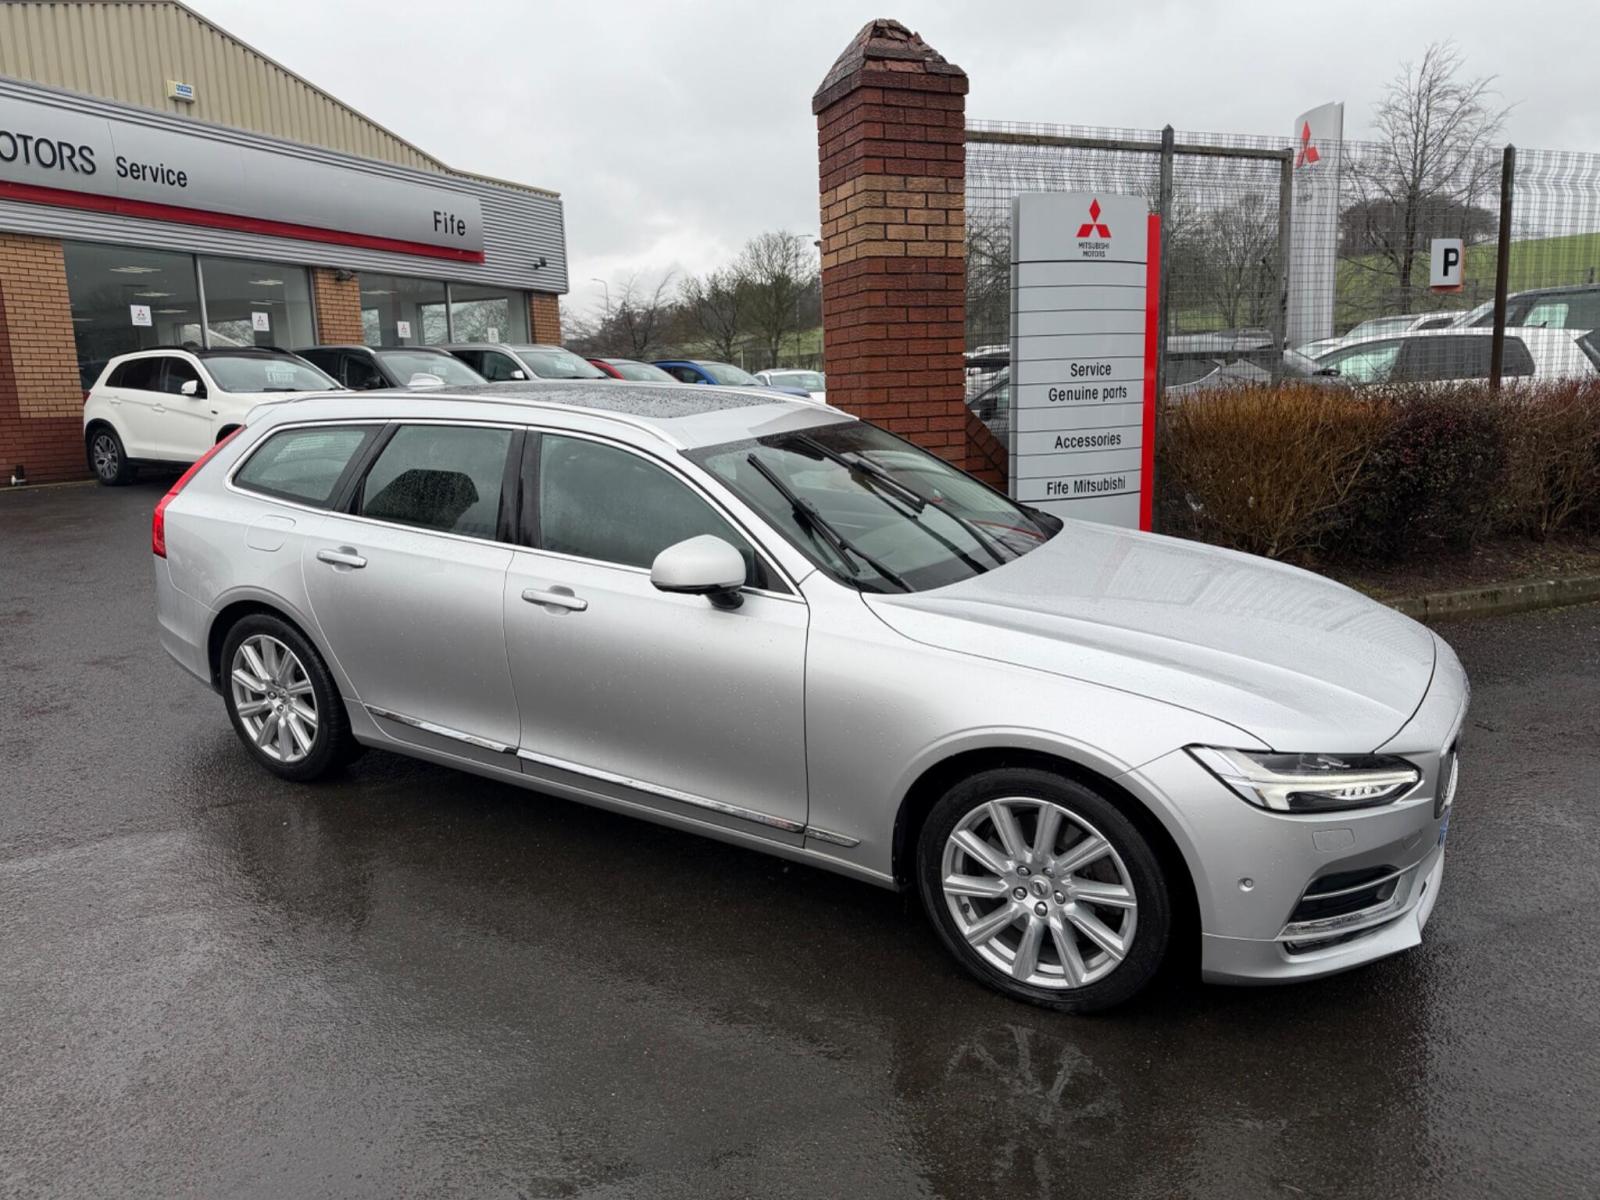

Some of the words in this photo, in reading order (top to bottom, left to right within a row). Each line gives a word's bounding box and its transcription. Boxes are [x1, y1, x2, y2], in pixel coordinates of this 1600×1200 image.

[115, 156, 188, 188] Service
[433, 210, 466, 237] Fife
[1443, 247, 1459, 277] P
[1070, 362, 1112, 377] Service
[1048, 386, 1099, 402] Genuine
[1102, 385, 1128, 402] parts
[1054, 432, 1122, 449] Accessories
[1046, 480, 1069, 496] Fife
[1073, 475, 1126, 493] Mitsubishi
